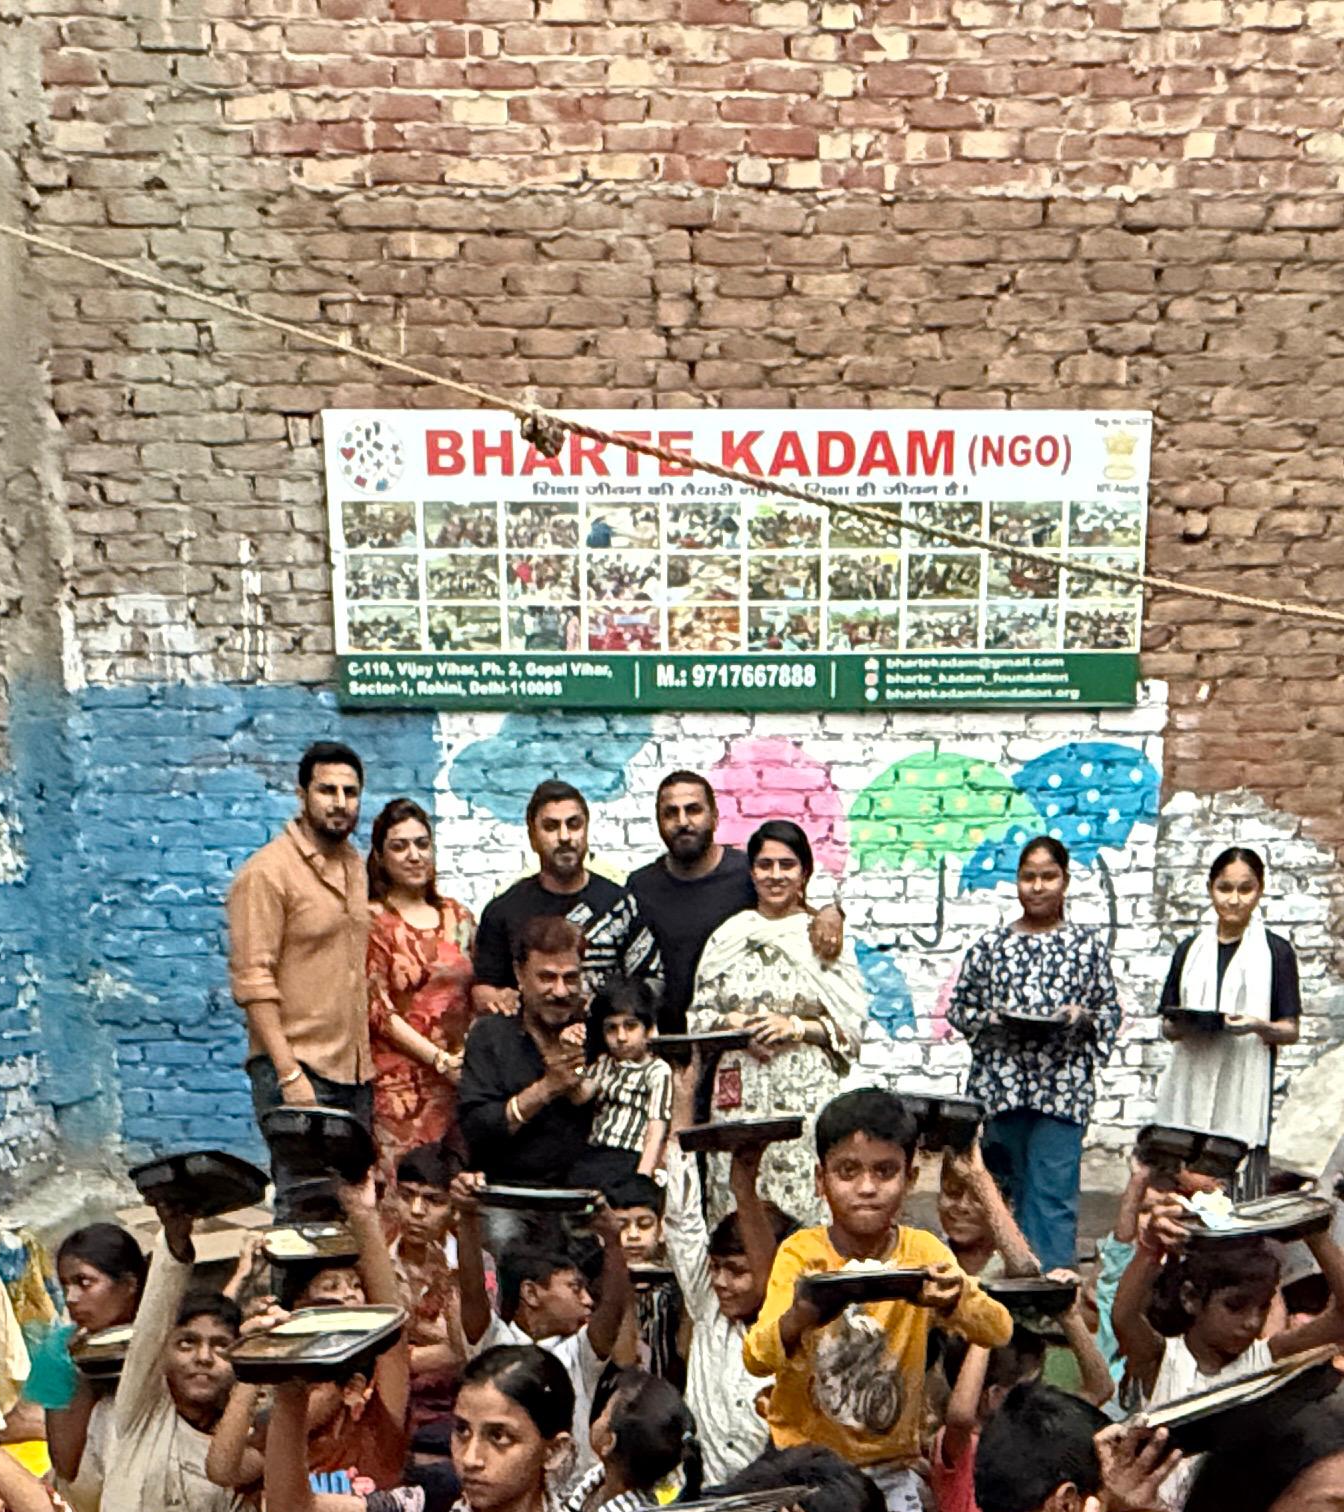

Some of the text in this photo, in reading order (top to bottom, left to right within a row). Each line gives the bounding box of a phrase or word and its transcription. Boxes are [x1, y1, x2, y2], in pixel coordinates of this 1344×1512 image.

[425, 428, 1072, 477] BHARTE KADAM (NGO)
[397, 662, 433, 679] Vijay
[436, 662, 479, 678] Vihar,
[482, 662, 505, 676] Ph.
[509, 661, 522, 678] 2,
[525, 662, 567, 679] Gopal
[571, 662, 614, 678] Vihar,
[657, 664, 816, 688] M.: 9717667888
[349, 681, 414, 696] Sector-1,
[417, 681, 467, 696] Rohini,
